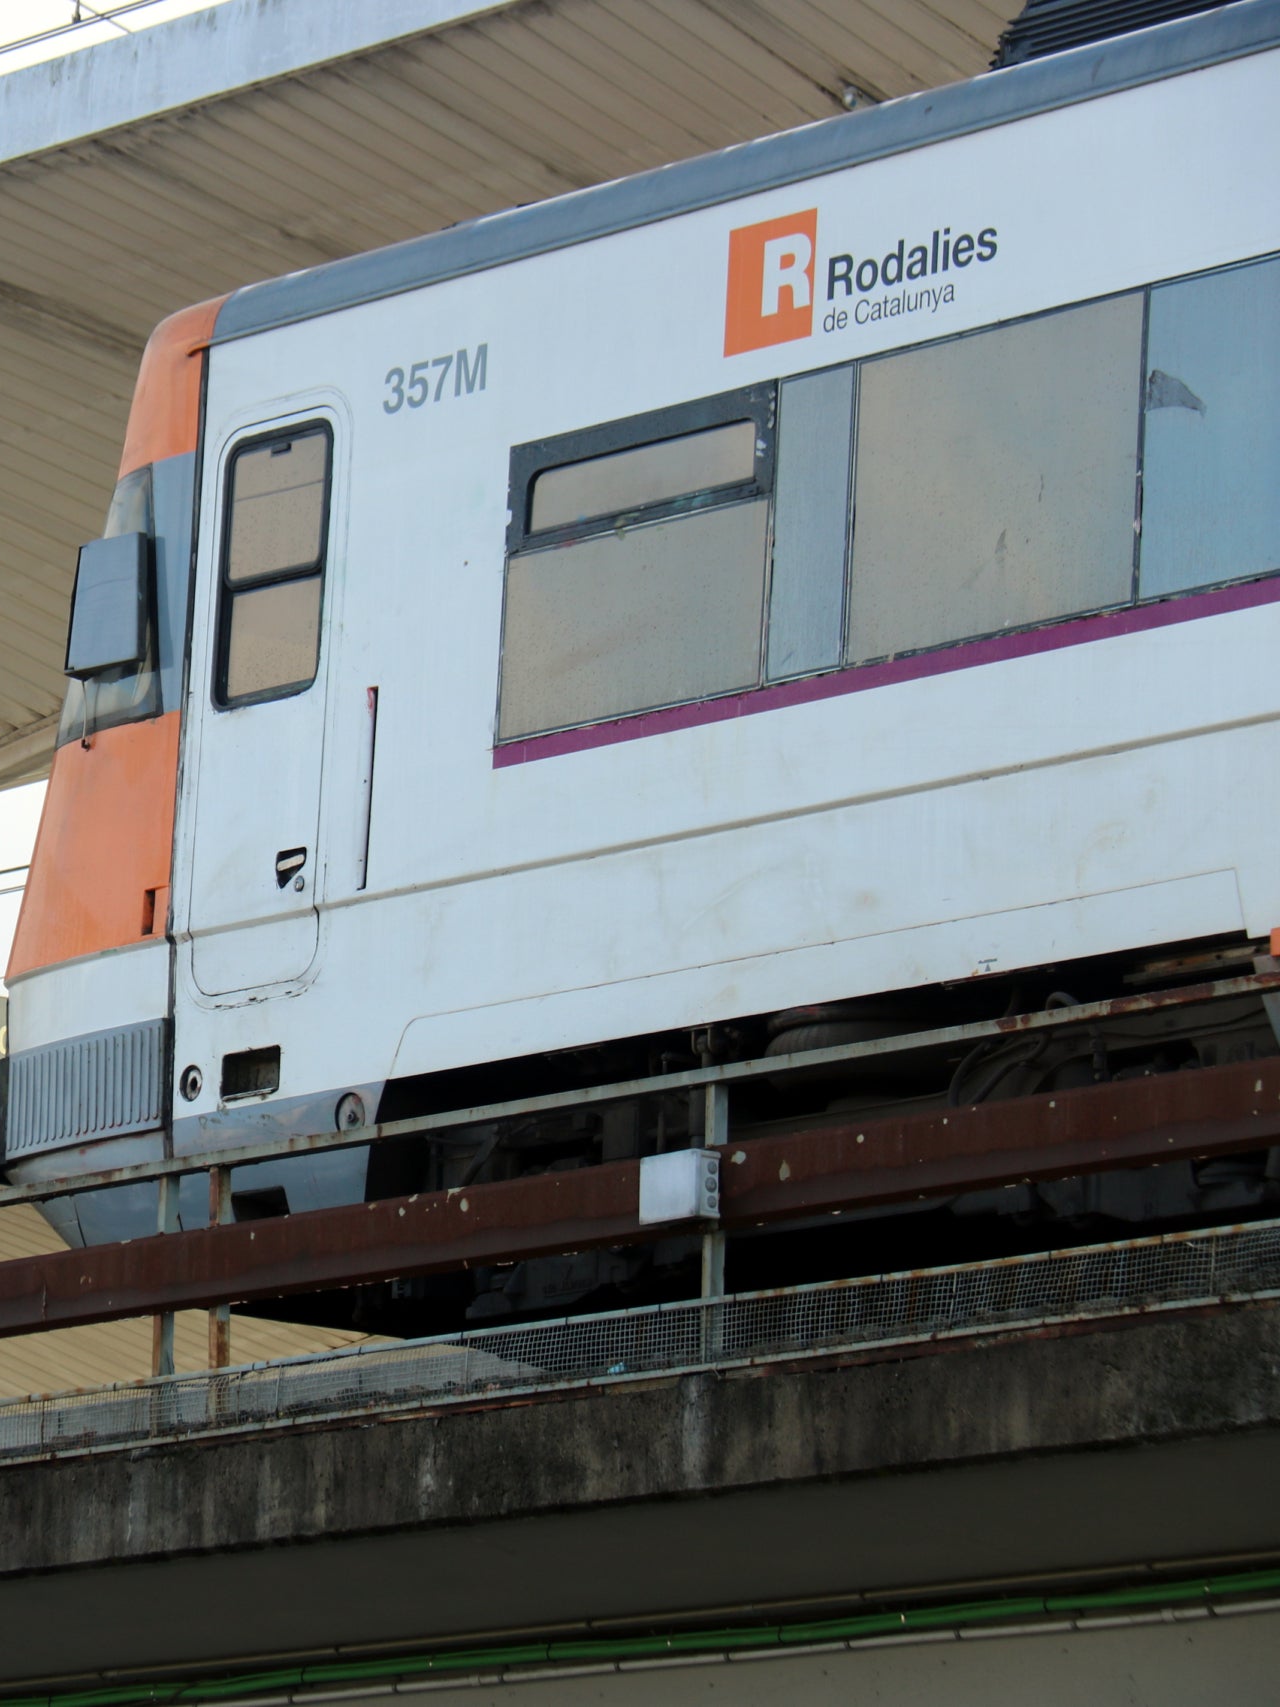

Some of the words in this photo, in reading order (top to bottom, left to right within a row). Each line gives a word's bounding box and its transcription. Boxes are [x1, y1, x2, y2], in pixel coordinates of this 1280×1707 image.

[761, 232, 812, 318] R
[826, 227, 998, 301] Rodalies
[823, 307, 848, 333] de
[854, 281, 956, 326] Catalunya
[382, 343, 488, 415] 357M
